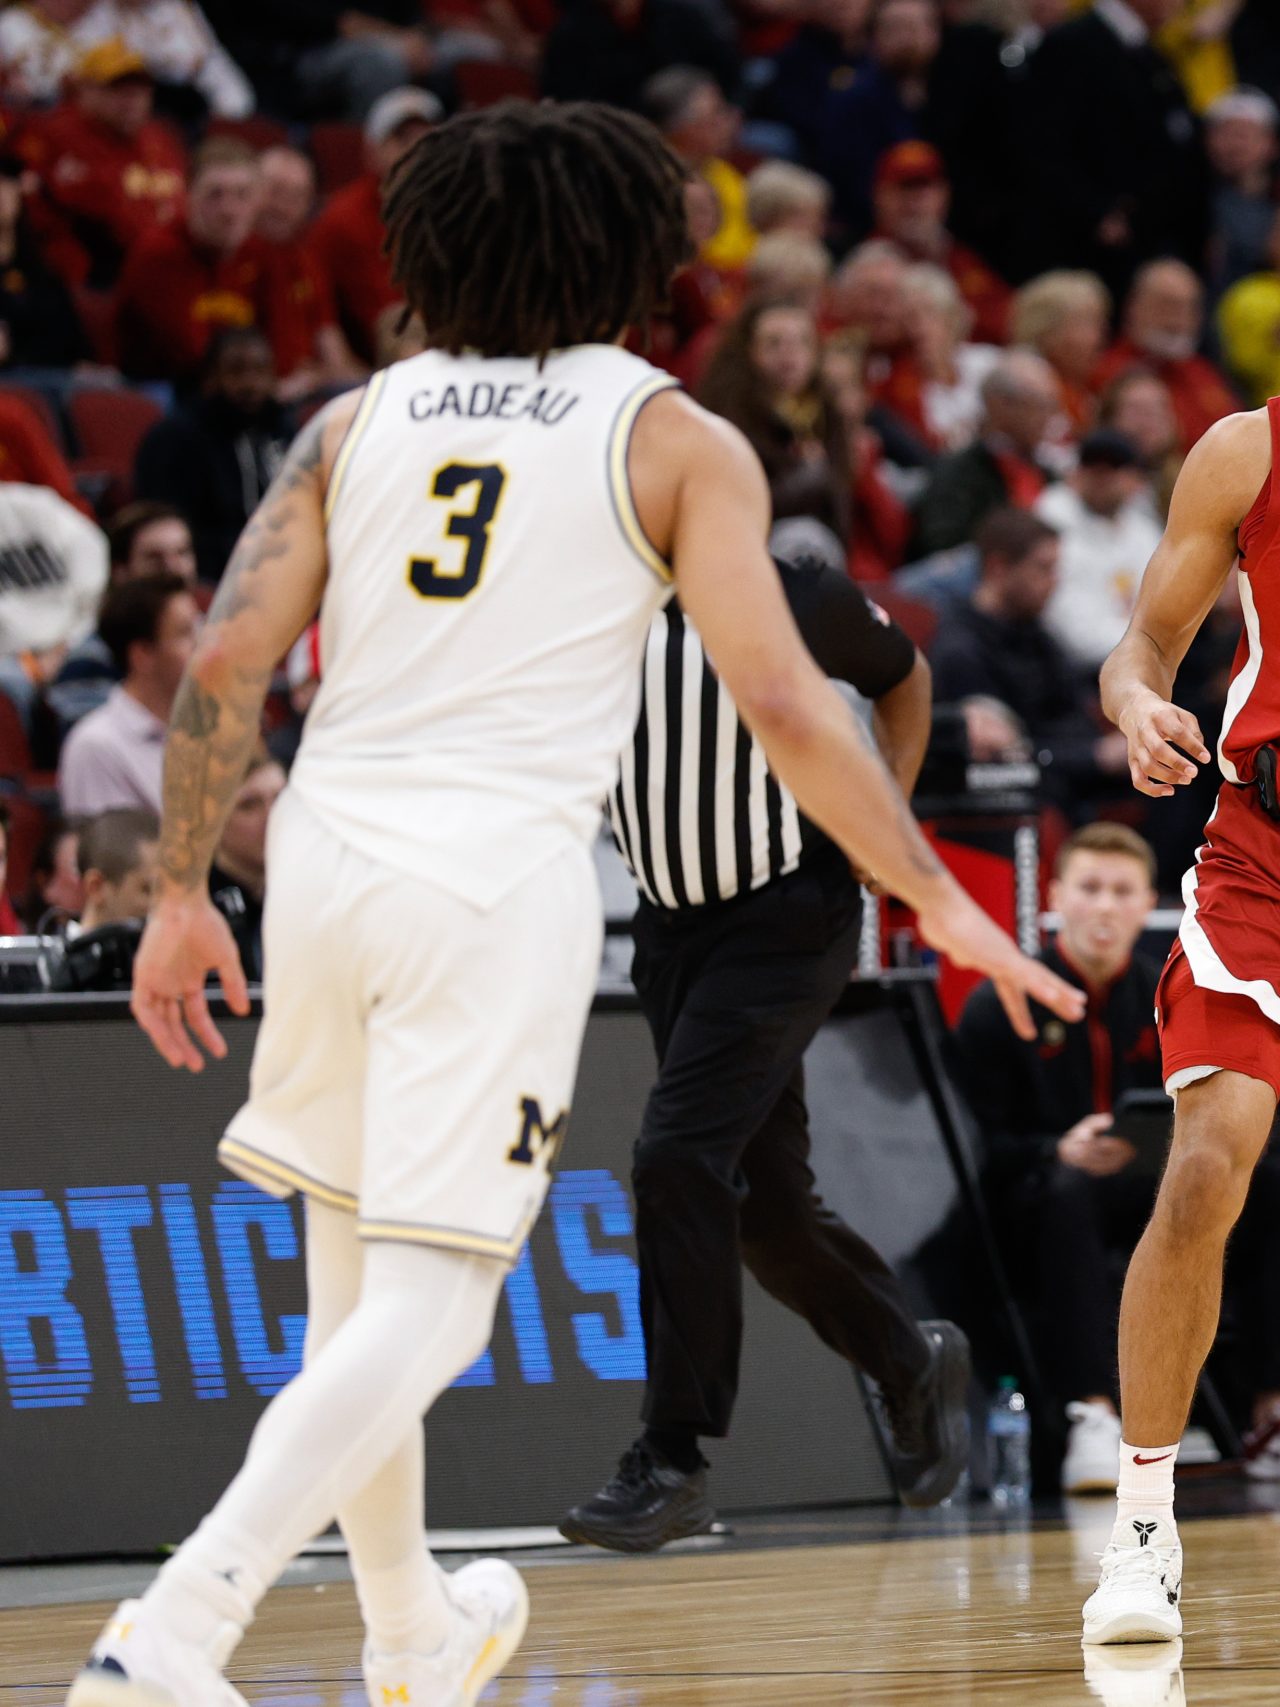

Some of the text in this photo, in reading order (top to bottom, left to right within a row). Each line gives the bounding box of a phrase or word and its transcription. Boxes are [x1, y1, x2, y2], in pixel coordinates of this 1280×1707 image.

[409, 383, 581, 426] CADEAU
[407, 459, 509, 601] 3
[0, 1169, 647, 1408] BTICS
